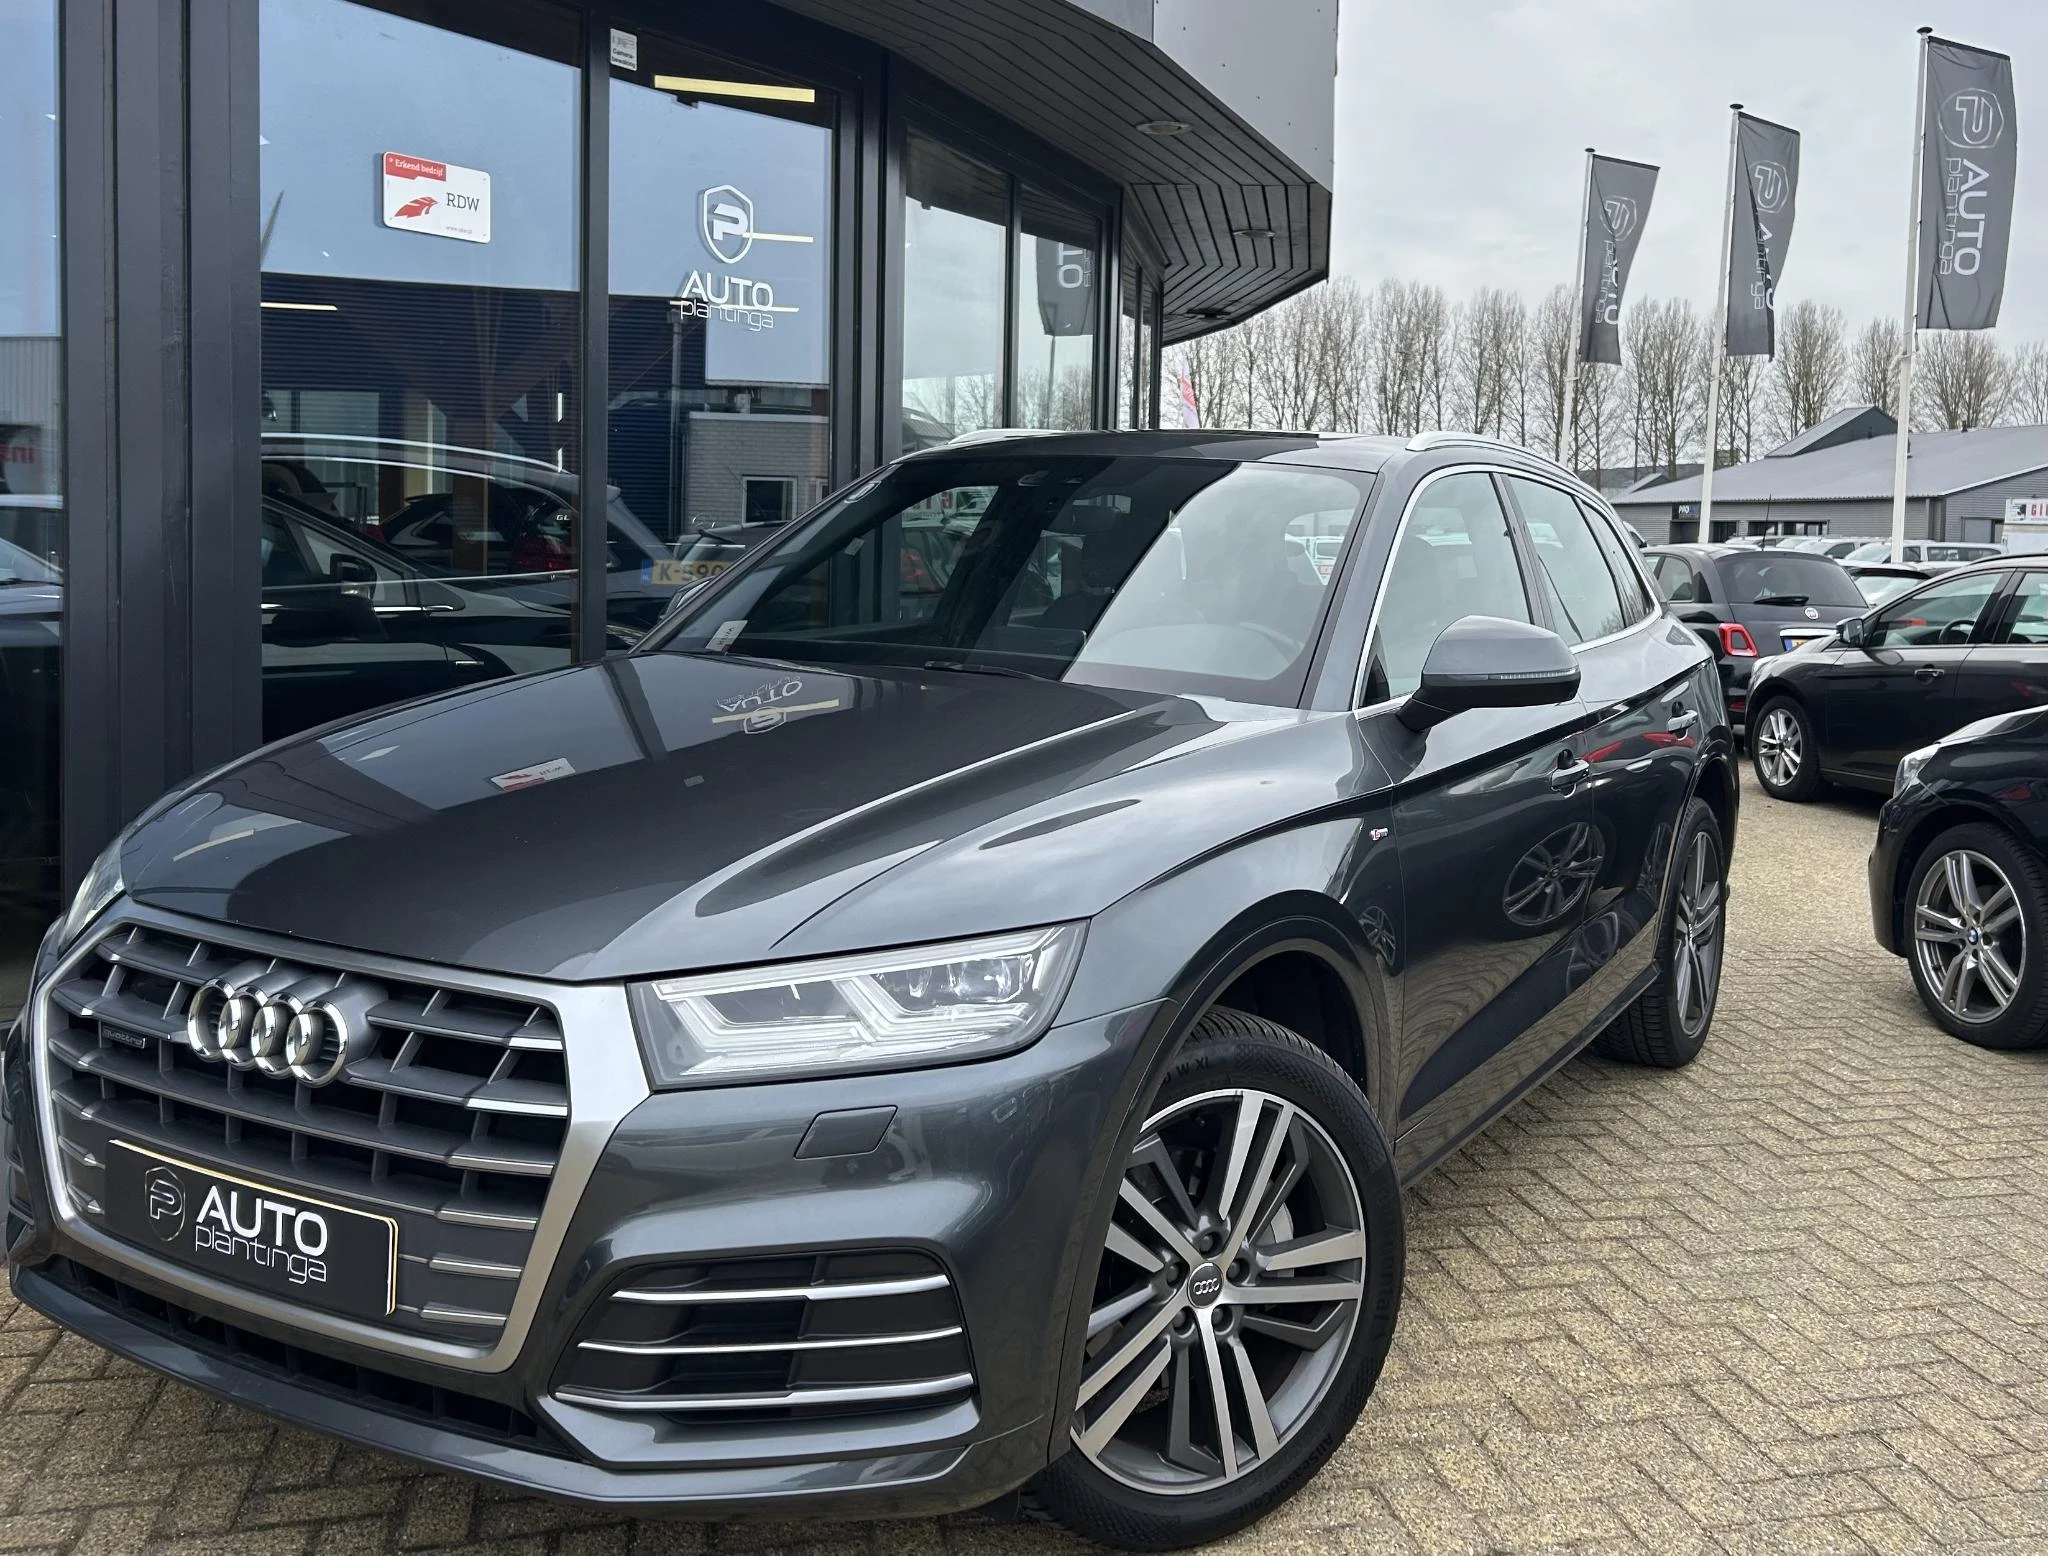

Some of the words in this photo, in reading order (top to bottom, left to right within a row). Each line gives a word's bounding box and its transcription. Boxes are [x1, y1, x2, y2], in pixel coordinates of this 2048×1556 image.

[395, 159, 420, 172] Erkend
[446, 192, 480, 213] RDW
[1938, 157, 1964, 276] plantinga
[1953, 158, 1990, 276] AUTO
[682, 270, 774, 311] AUTO
[680, 298, 774, 332] plantinga
[102, 1029, 143, 1046] quattro
[196, 1185, 328, 1257] AUTO
[195, 1225, 327, 1285] plantinga
